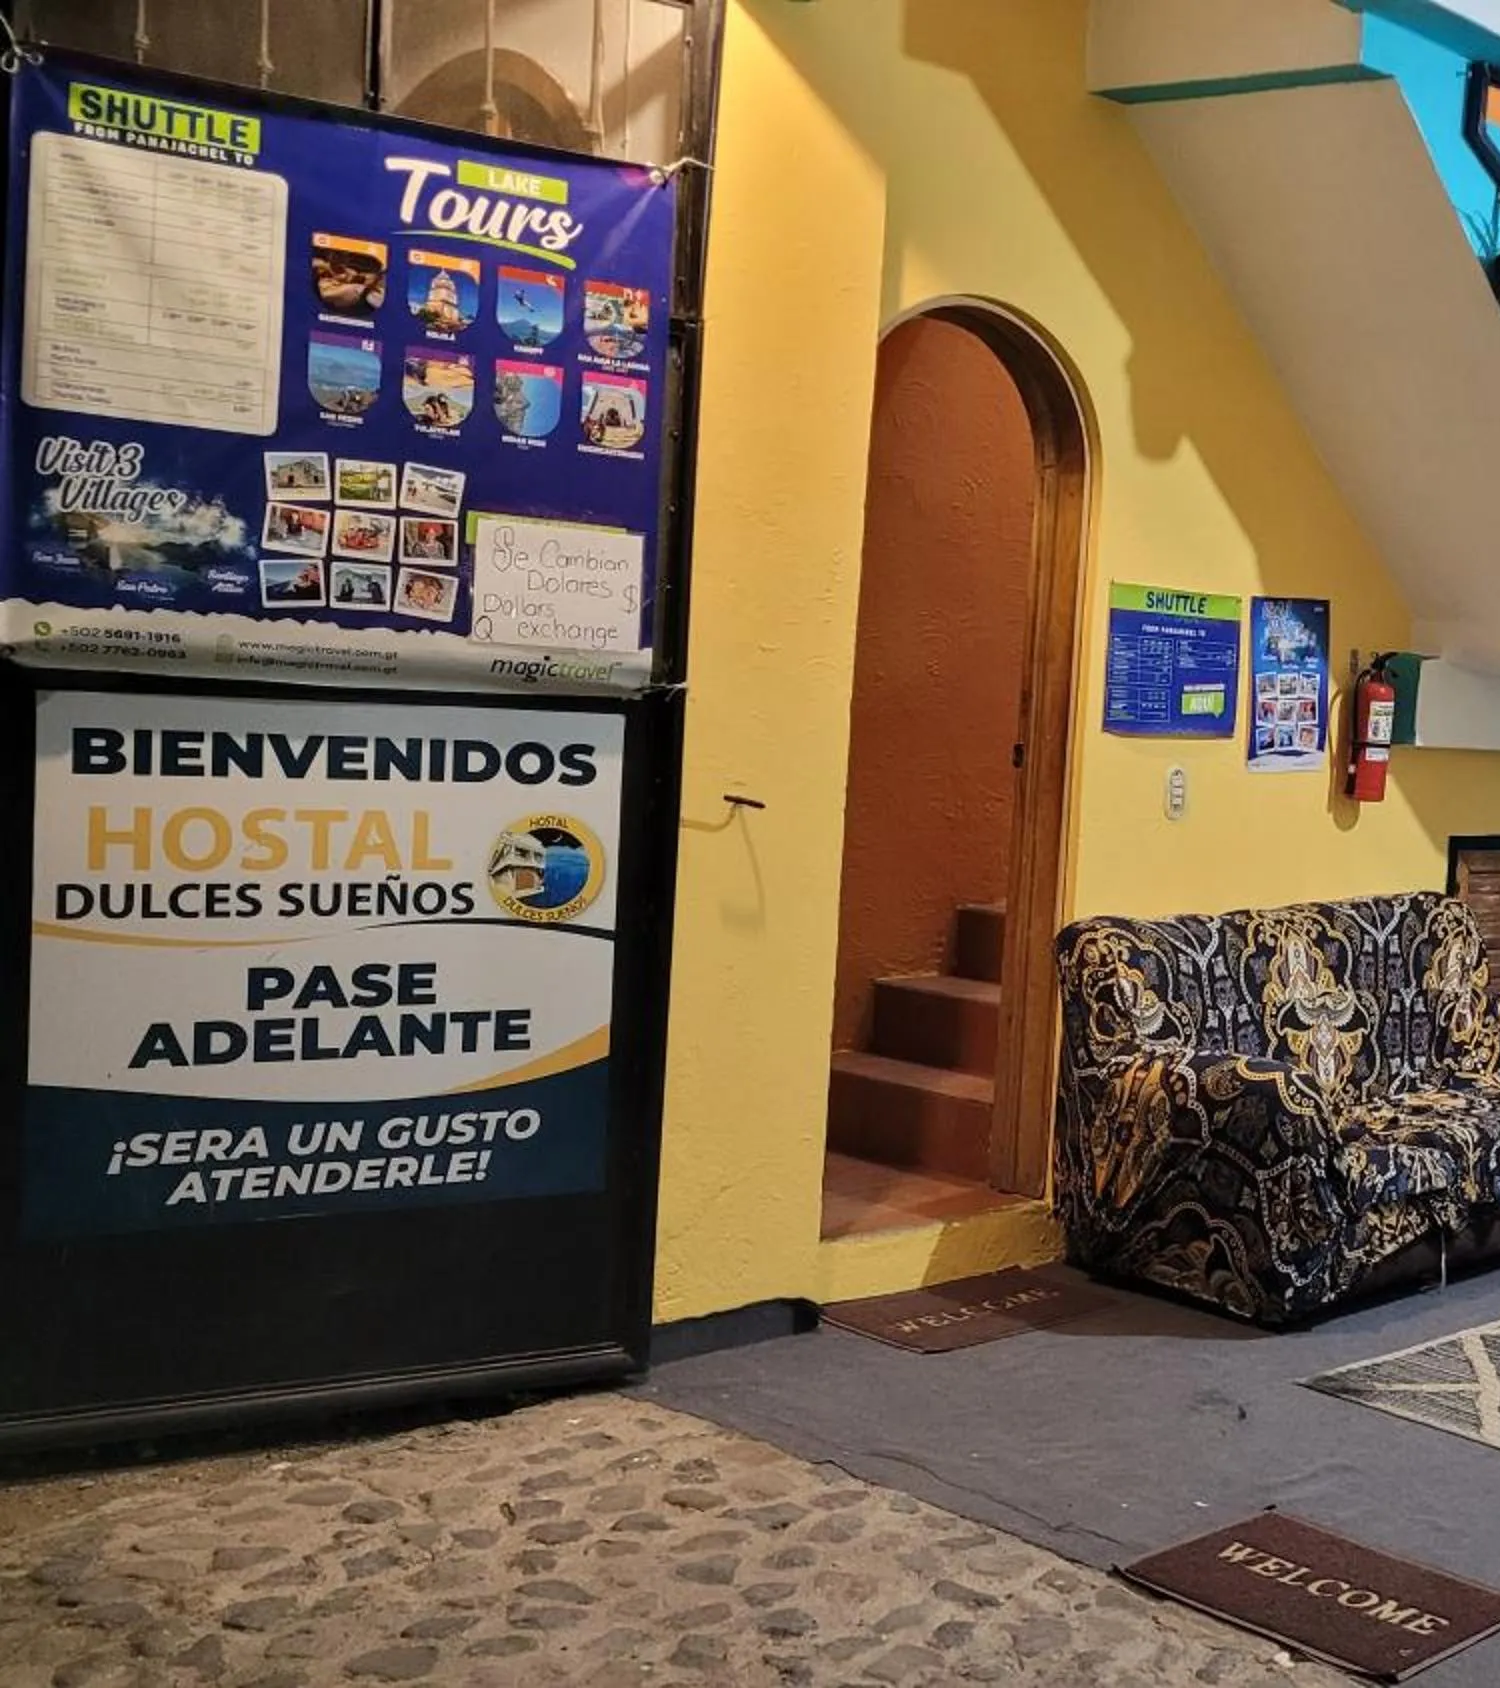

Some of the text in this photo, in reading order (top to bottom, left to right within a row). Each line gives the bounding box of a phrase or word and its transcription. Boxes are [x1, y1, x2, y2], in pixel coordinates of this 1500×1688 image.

[80, 90, 250, 148] SHUTTLE
[73, 122, 254, 166] FROM PANAJACHEL TO
[384, 157, 583, 251] Tours
[487, 171, 541, 194] LAKE
[36, 436, 145, 480] Visit 3
[59, 475, 187, 523] Villages
[539, 539, 629, 572] Cambian
[483, 593, 556, 618] Dollars
[527, 569, 613, 598] Dolares
[1146, 591, 1208, 614] SHUTTLE
[61, 625, 101, 638] +502
[473, 615, 619, 649] Q exchange
[489, 656, 617, 682] magictravel
[72, 728, 598, 786] BIENVENIDOS
[87, 806, 453, 874] HOSTAL
[528, 815, 569, 828] HOSTAL
[56, 874, 475, 919] DULCES SUEÑOS
[246, 962, 437, 1010] PASE
[129, 1009, 532, 1069] ADELANTE
[107, 1108, 542, 1176] ¡SERA UN GUSTO
[166, 1150, 491, 1206] ATENDERLE!
[1217, 1541, 1453, 1639] WELCOME
